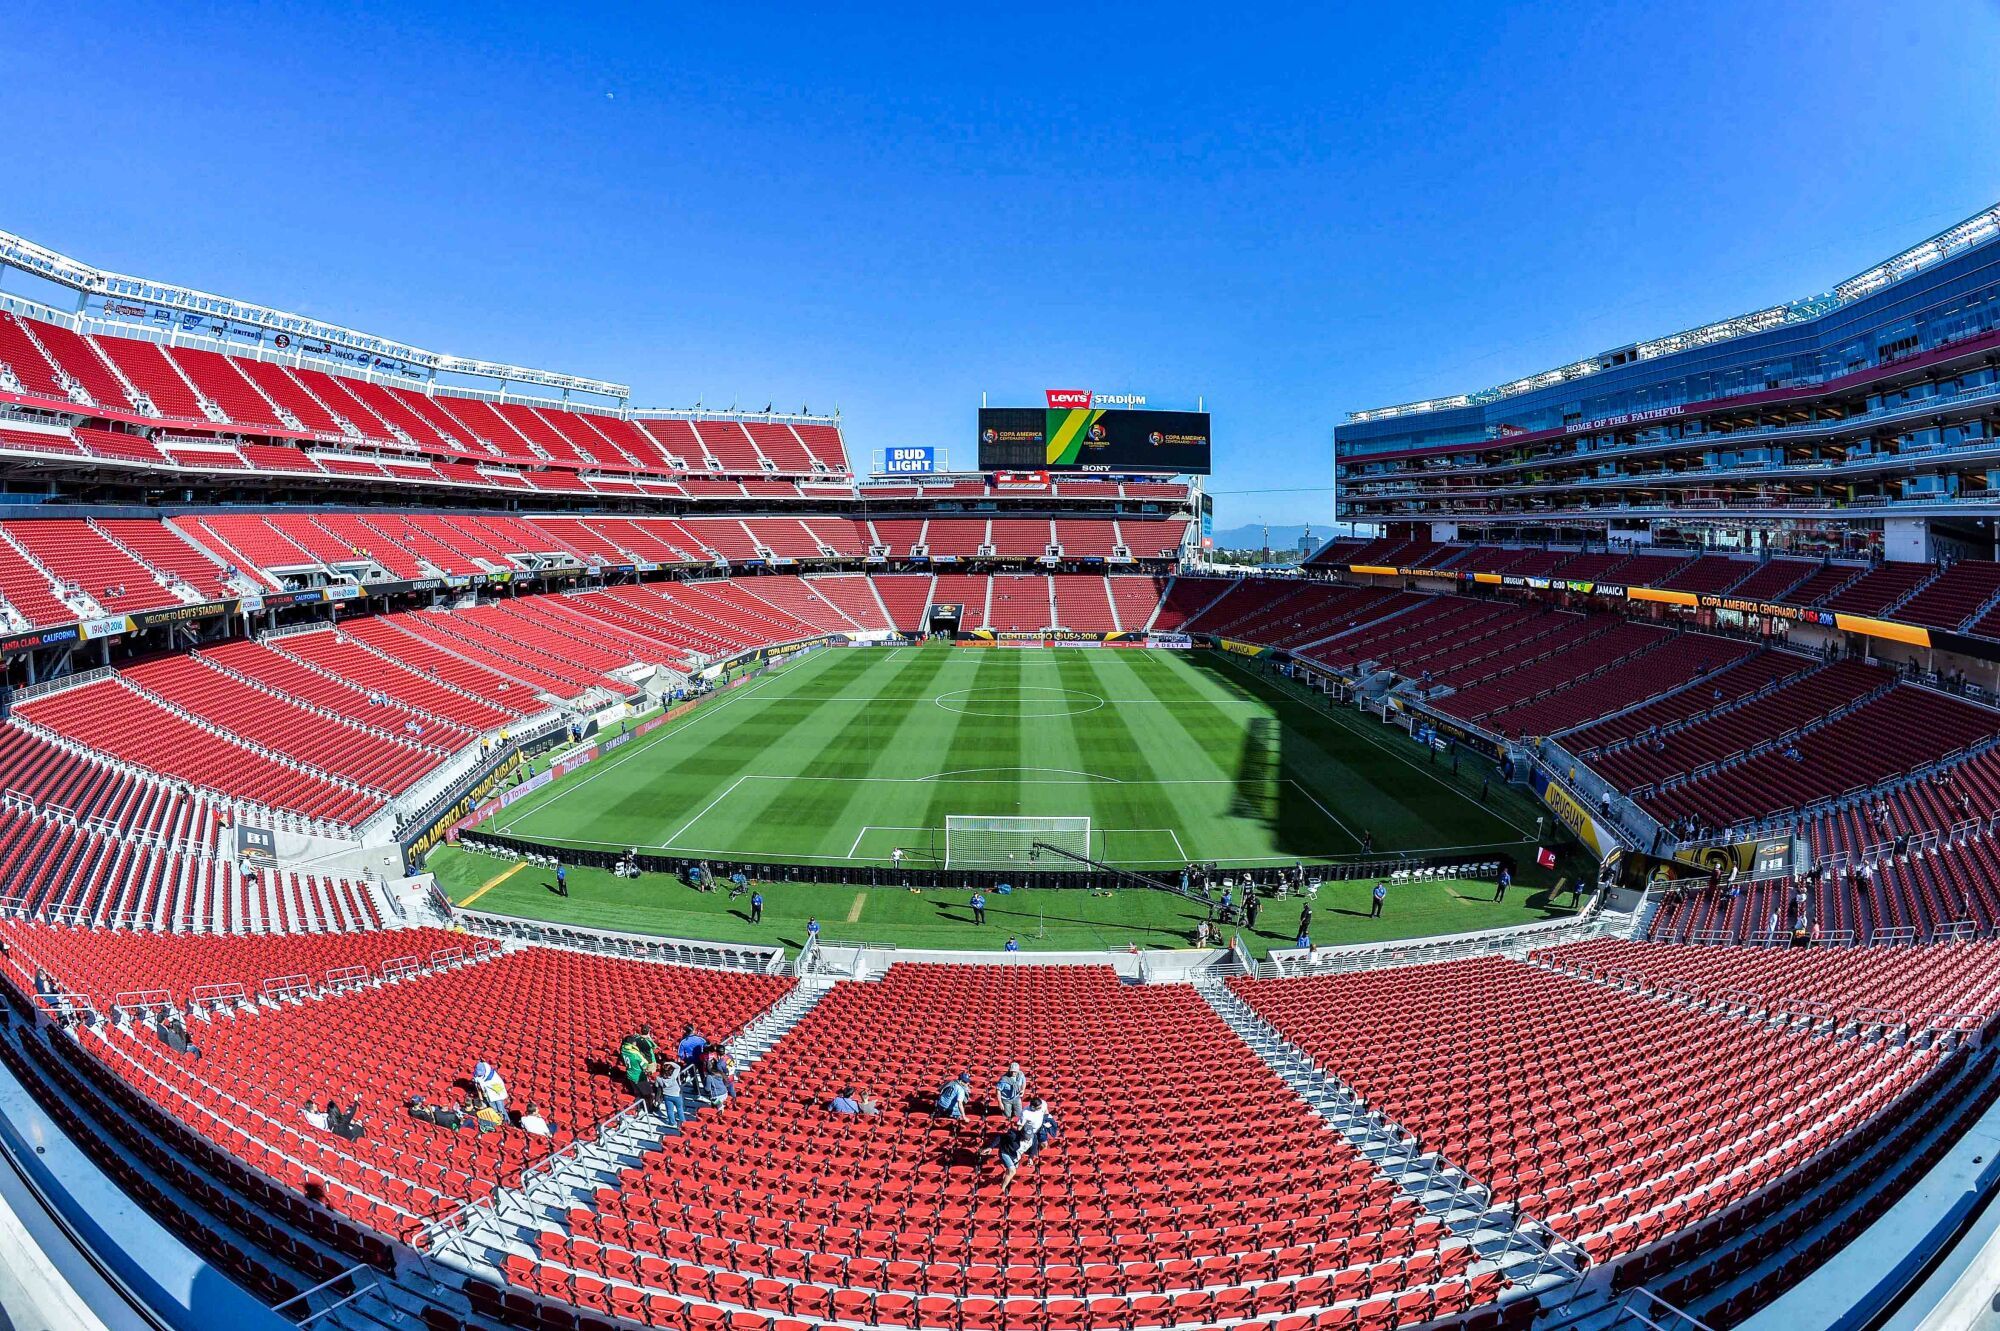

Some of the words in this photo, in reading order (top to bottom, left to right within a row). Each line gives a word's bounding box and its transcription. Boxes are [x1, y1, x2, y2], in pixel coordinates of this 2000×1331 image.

[184, 316, 198, 327] SAP
[211, 326, 223, 336] nrg
[233, 328, 255, 338] UNITED
[303, 344, 323, 354] BROCADE
[1094, 394, 1146, 404] STADIUM
[1566, 422, 1592, 433] HOME
[1594, 419, 1608, 428] OF
[1608, 416, 1628, 426] THE
[1631, 406, 1684, 422] FAITHFUL
[894, 448, 926, 460] BUD
[888, 460, 932, 472] LIGHT
[1400, 568, 1412, 576] COPA
[1412, 569, 1434, 577] AMERICA
[412, 580, 441, 590] URUGUAY
[474, 576, 487, 584] 0:00
[514, 572, 535, 582] JAMAICA
[1503, 576, 1525, 586] URUGUAY
[1552, 580, 1566, 590] 0:00
[1596, 585, 1624, 596] JAMAICA
[294, 593, 320, 602] CALIFORNIA
[144, 612, 168, 624] WELCOME
[168, 612, 178, 621] TO
[198, 604, 225, 616] STADIUM
[1702, 596, 1721, 608] COPA
[1722, 599, 1758, 613] AMERICA
[1760, 603, 1797, 619] CENTENARIO
[1805, 608, 1818, 621] USA
[1819, 612, 1834, 626] 2016
[91, 624, 103, 635] 1916
[110, 620, 123, 632] 2016
[2, 641, 20, 652] SANTA
[20, 636, 40, 648] CLARA
[42, 630, 76, 644] CALIFORNIA
[768, 648, 780, 657] COPA
[780, 643, 801, 654] AMERICA
[606, 732, 630, 751] SAMSUNG
[510, 786, 530, 800] TOTAL
[408, 834, 430, 864] COPA
[430, 806, 460, 846] AMERICA
[460, 775, 494, 816] CETENARIO
[499, 764, 509, 778] USA
[1550, 787, 1586, 834] URUGUAY
